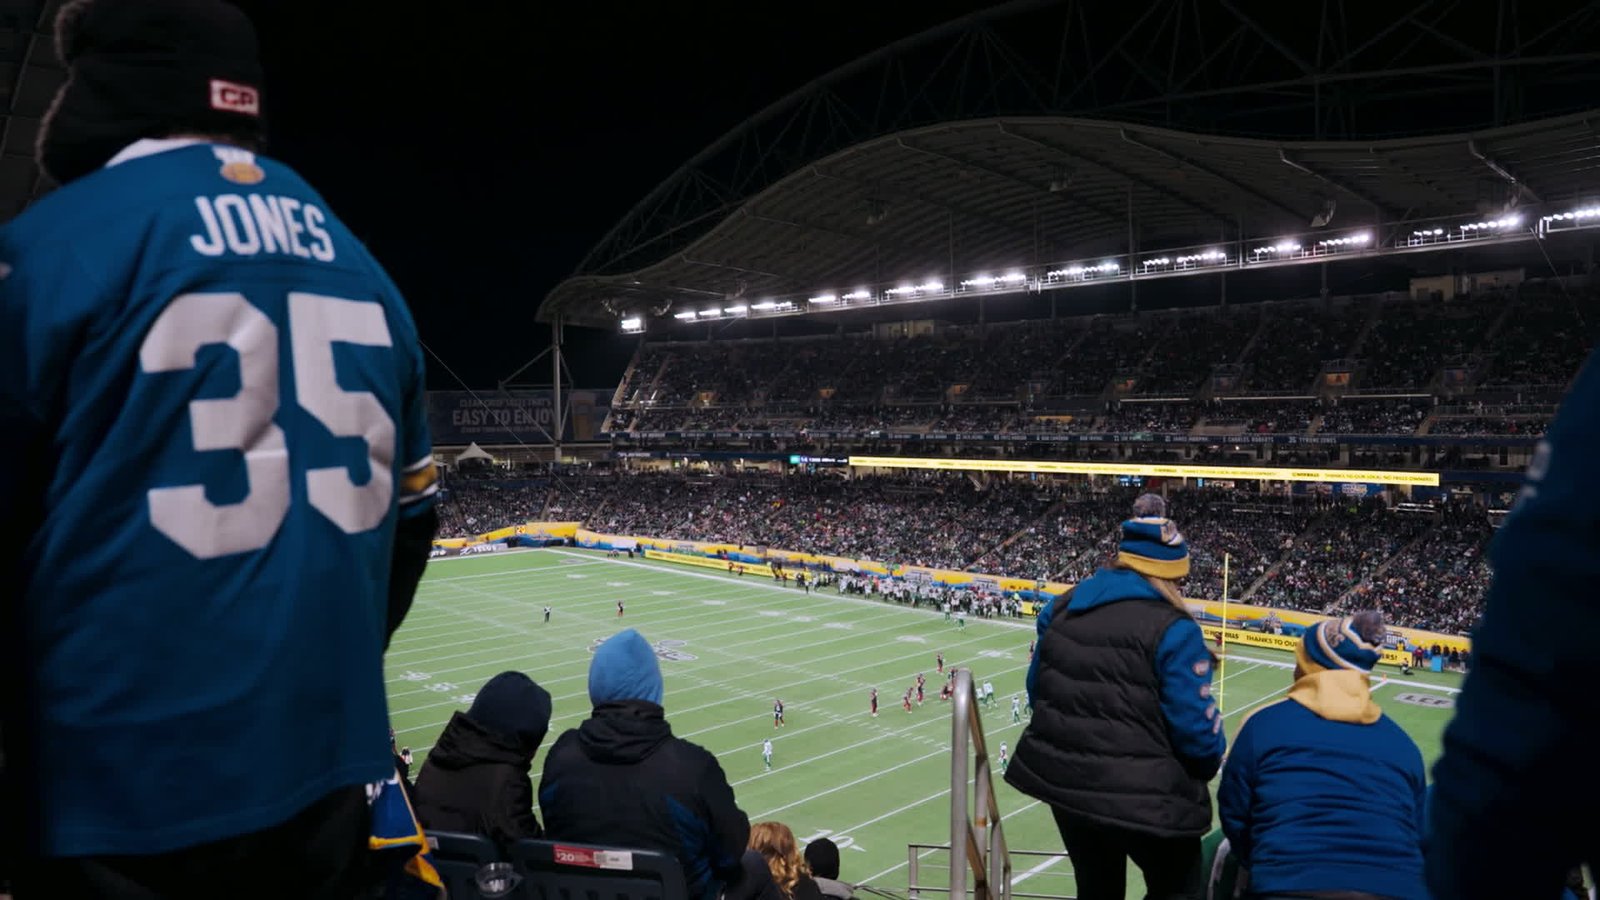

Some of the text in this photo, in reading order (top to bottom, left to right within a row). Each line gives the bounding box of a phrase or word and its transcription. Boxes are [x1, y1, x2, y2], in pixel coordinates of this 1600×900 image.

[190, 193, 337, 264] JONES
[140, 291, 396, 561] 35
[452, 409, 490, 426] EASY
[491, 408, 511, 425] TO
[1246, 634, 1273, 645] THANKS
[1274, 637, 1283, 645] TO
